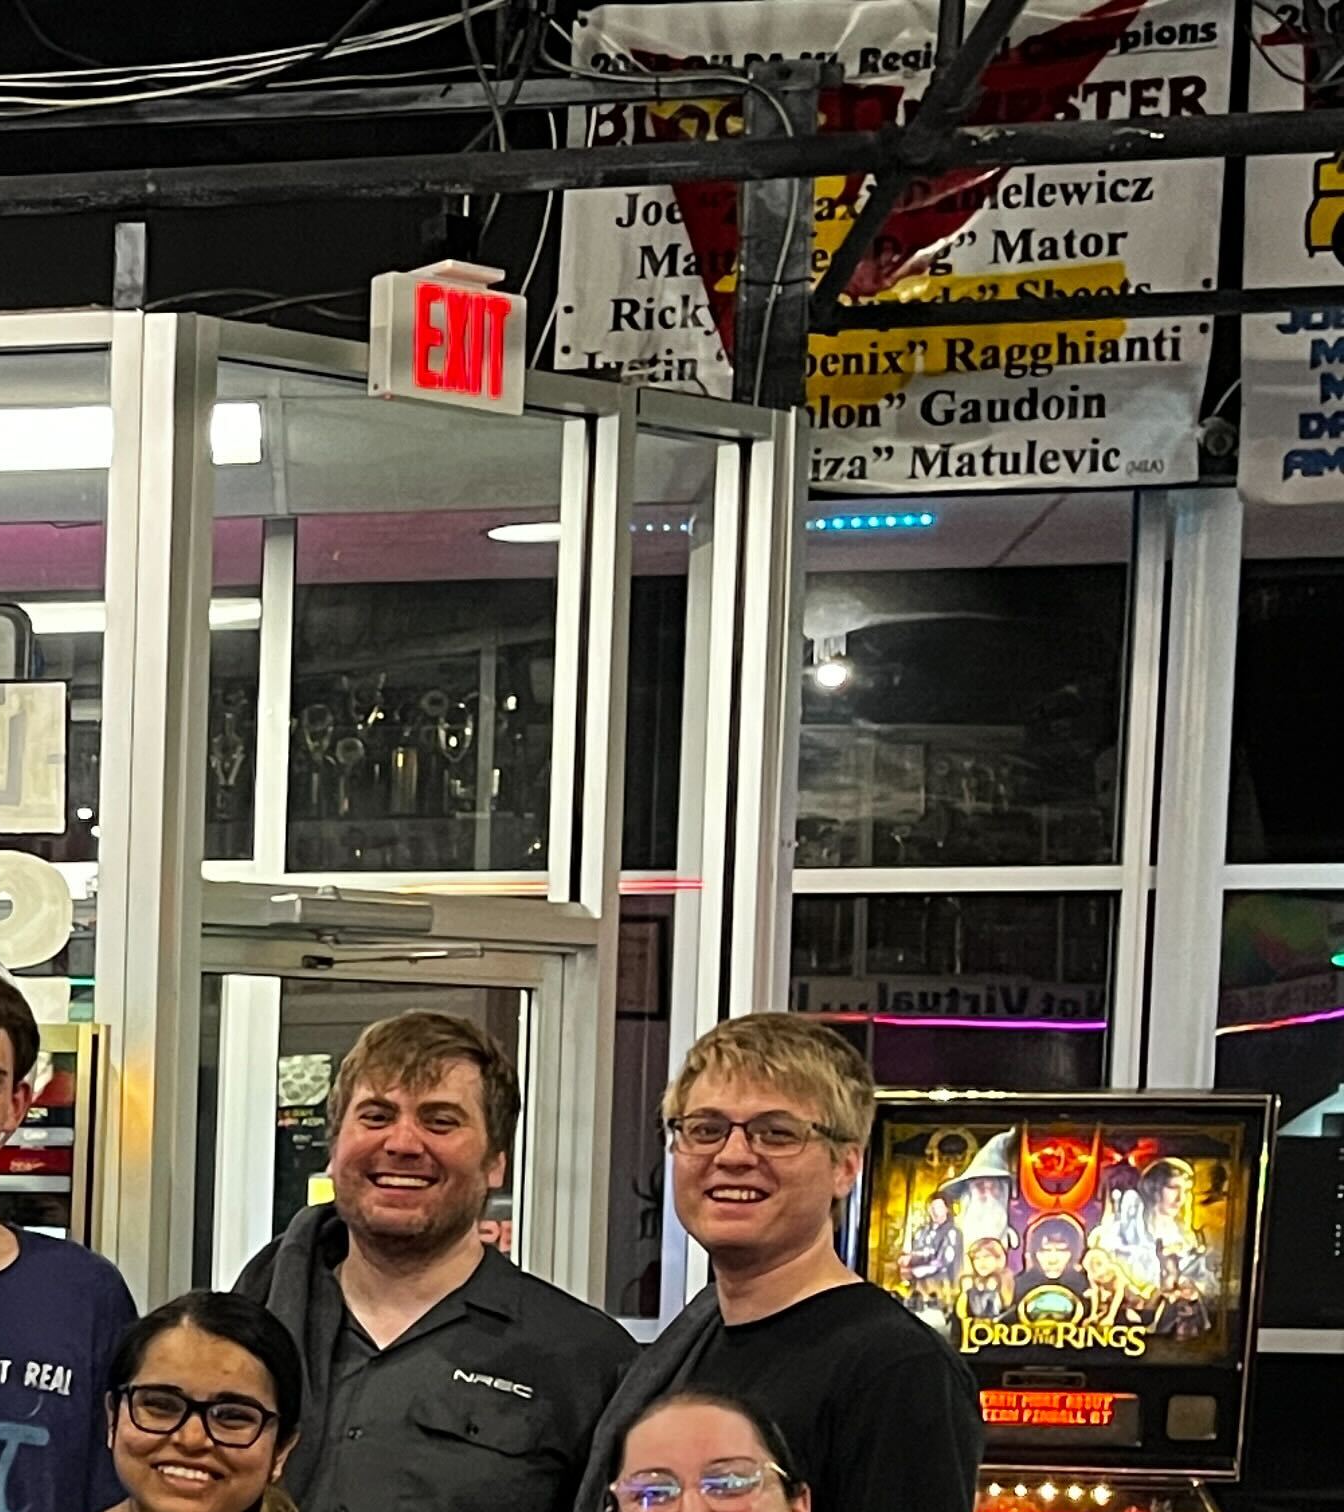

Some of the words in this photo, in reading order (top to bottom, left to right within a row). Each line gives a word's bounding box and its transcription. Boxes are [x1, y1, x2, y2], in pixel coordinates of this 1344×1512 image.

[615, 193, 684, 229] Joe
[992, 229, 1128, 266] Mator
[609, 294, 717, 338] Ricky
[414, 282, 511, 399] EXIT
[583, 349, 699, 383] Jutin
[945, 323, 1183, 379] Ragghianti
[919, 385, 1107, 427] Gaudoin
[908, 437, 1122, 481] Matulevic
[959, 1317, 1032, 1353] LORD
[1055, 1322, 1147, 1357] RINGS
[24, 1360, 73, 1396] REAL
